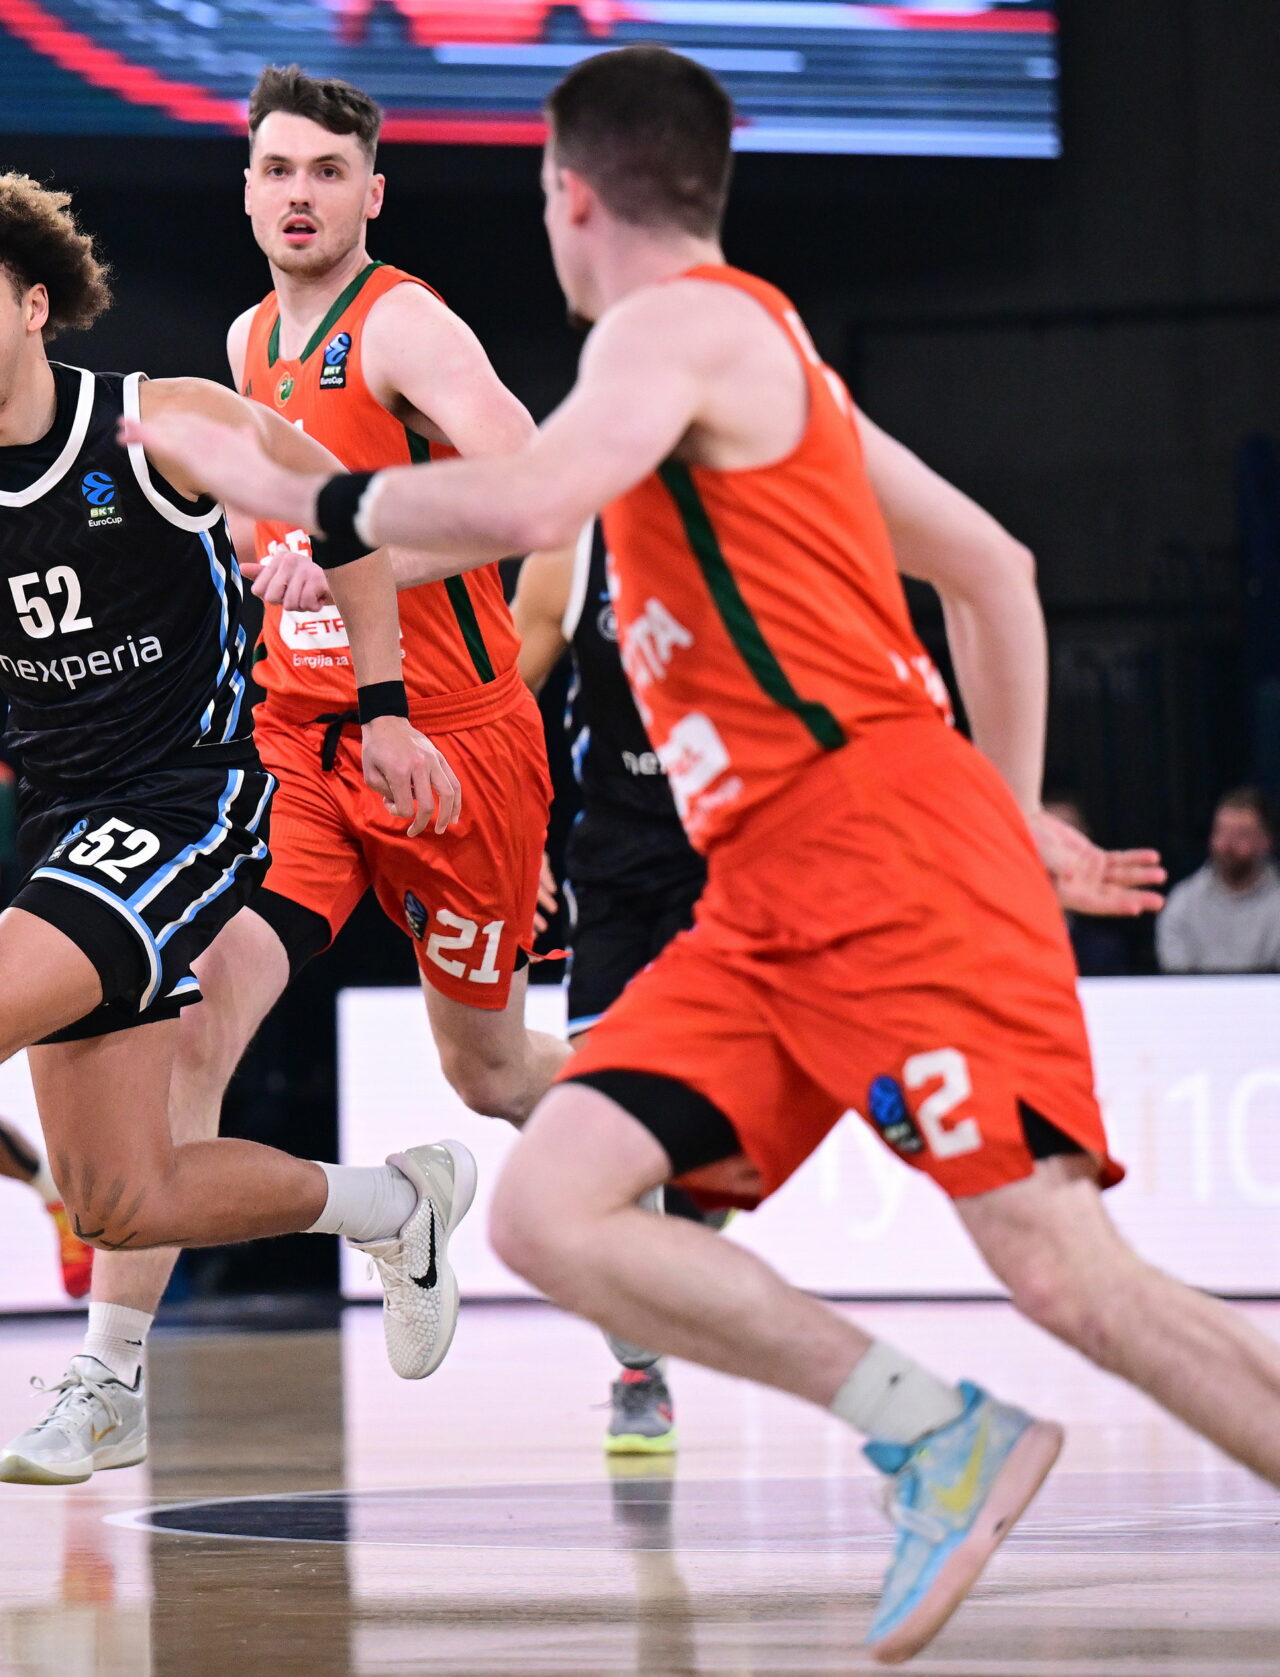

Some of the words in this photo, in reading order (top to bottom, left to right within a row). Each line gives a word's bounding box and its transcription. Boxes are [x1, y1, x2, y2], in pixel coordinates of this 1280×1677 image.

[88, 516, 122, 527] EuroCup
[90, 506, 115, 518] BKT
[8, 565, 94, 639] 52
[68, 816, 161, 884] 52
[426, 908, 505, 984] 21
[902, 1047, 982, 1160] 2
